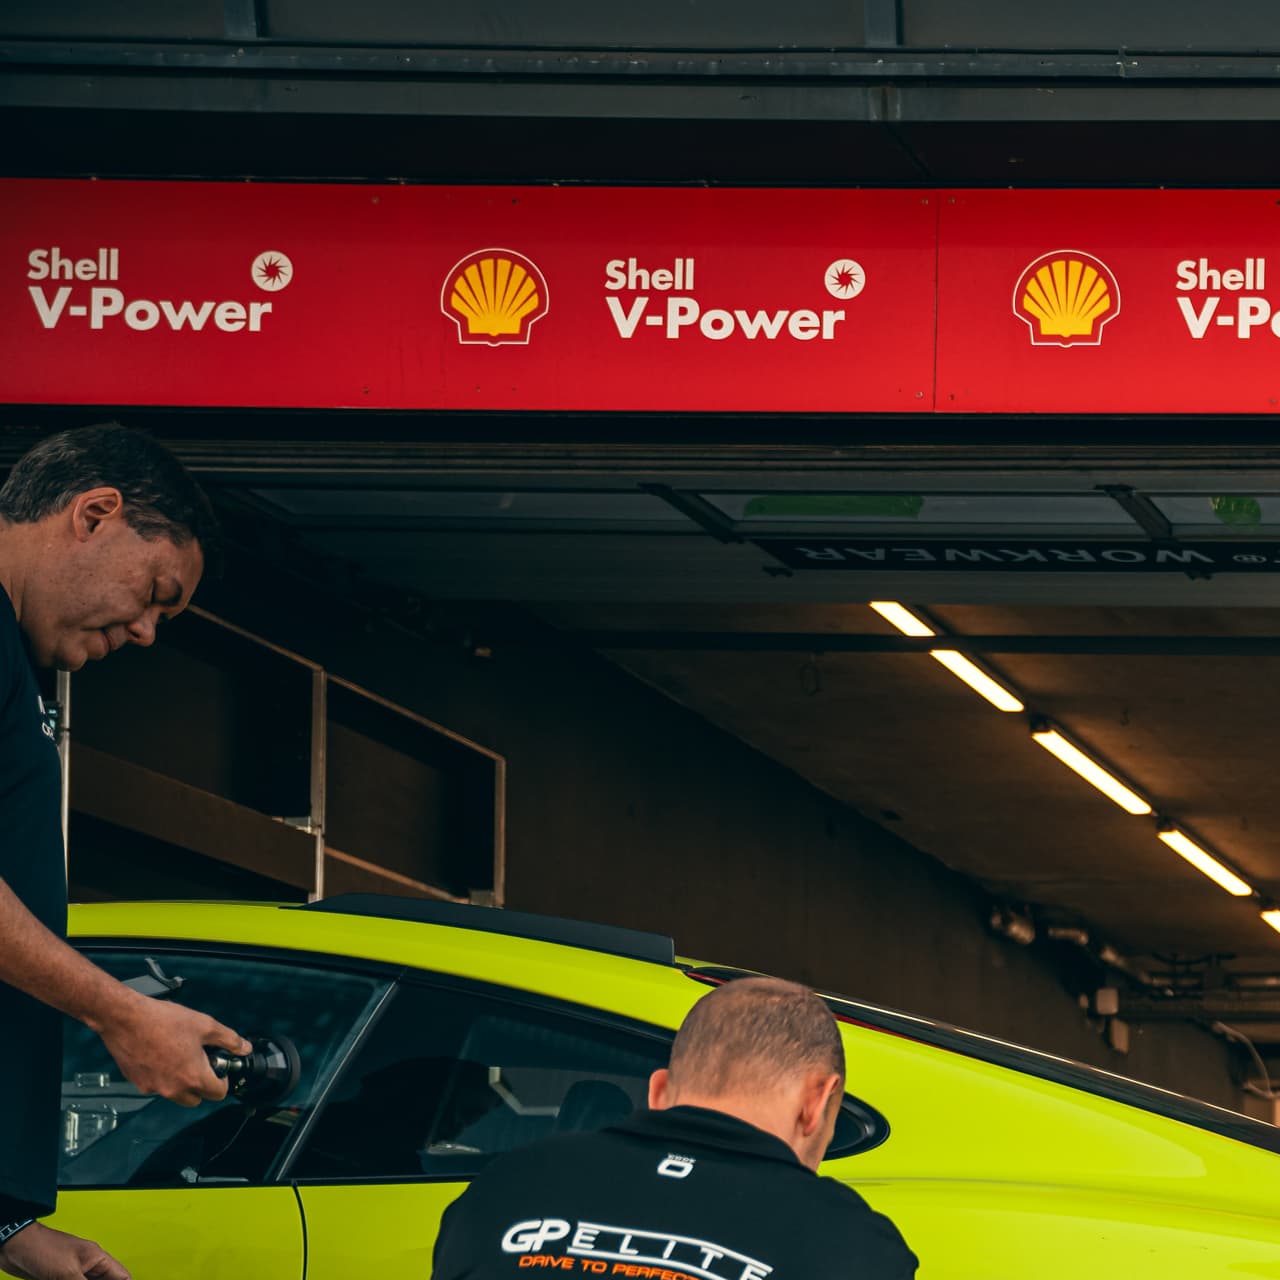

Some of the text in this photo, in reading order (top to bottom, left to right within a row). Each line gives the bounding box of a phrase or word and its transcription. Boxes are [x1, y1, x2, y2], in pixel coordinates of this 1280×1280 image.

[28, 248, 119, 280] Shell
[605, 258, 695, 290] Shell
[1176, 258, 1266, 290] Shell
[28, 287, 272, 332] V-Power
[605, 297, 846, 341] V-Power
[792, 546, 1215, 564] WORKWEAR
[518, 1255, 575, 1269] DRIVE
[581, 1259, 608, 1274] TO
